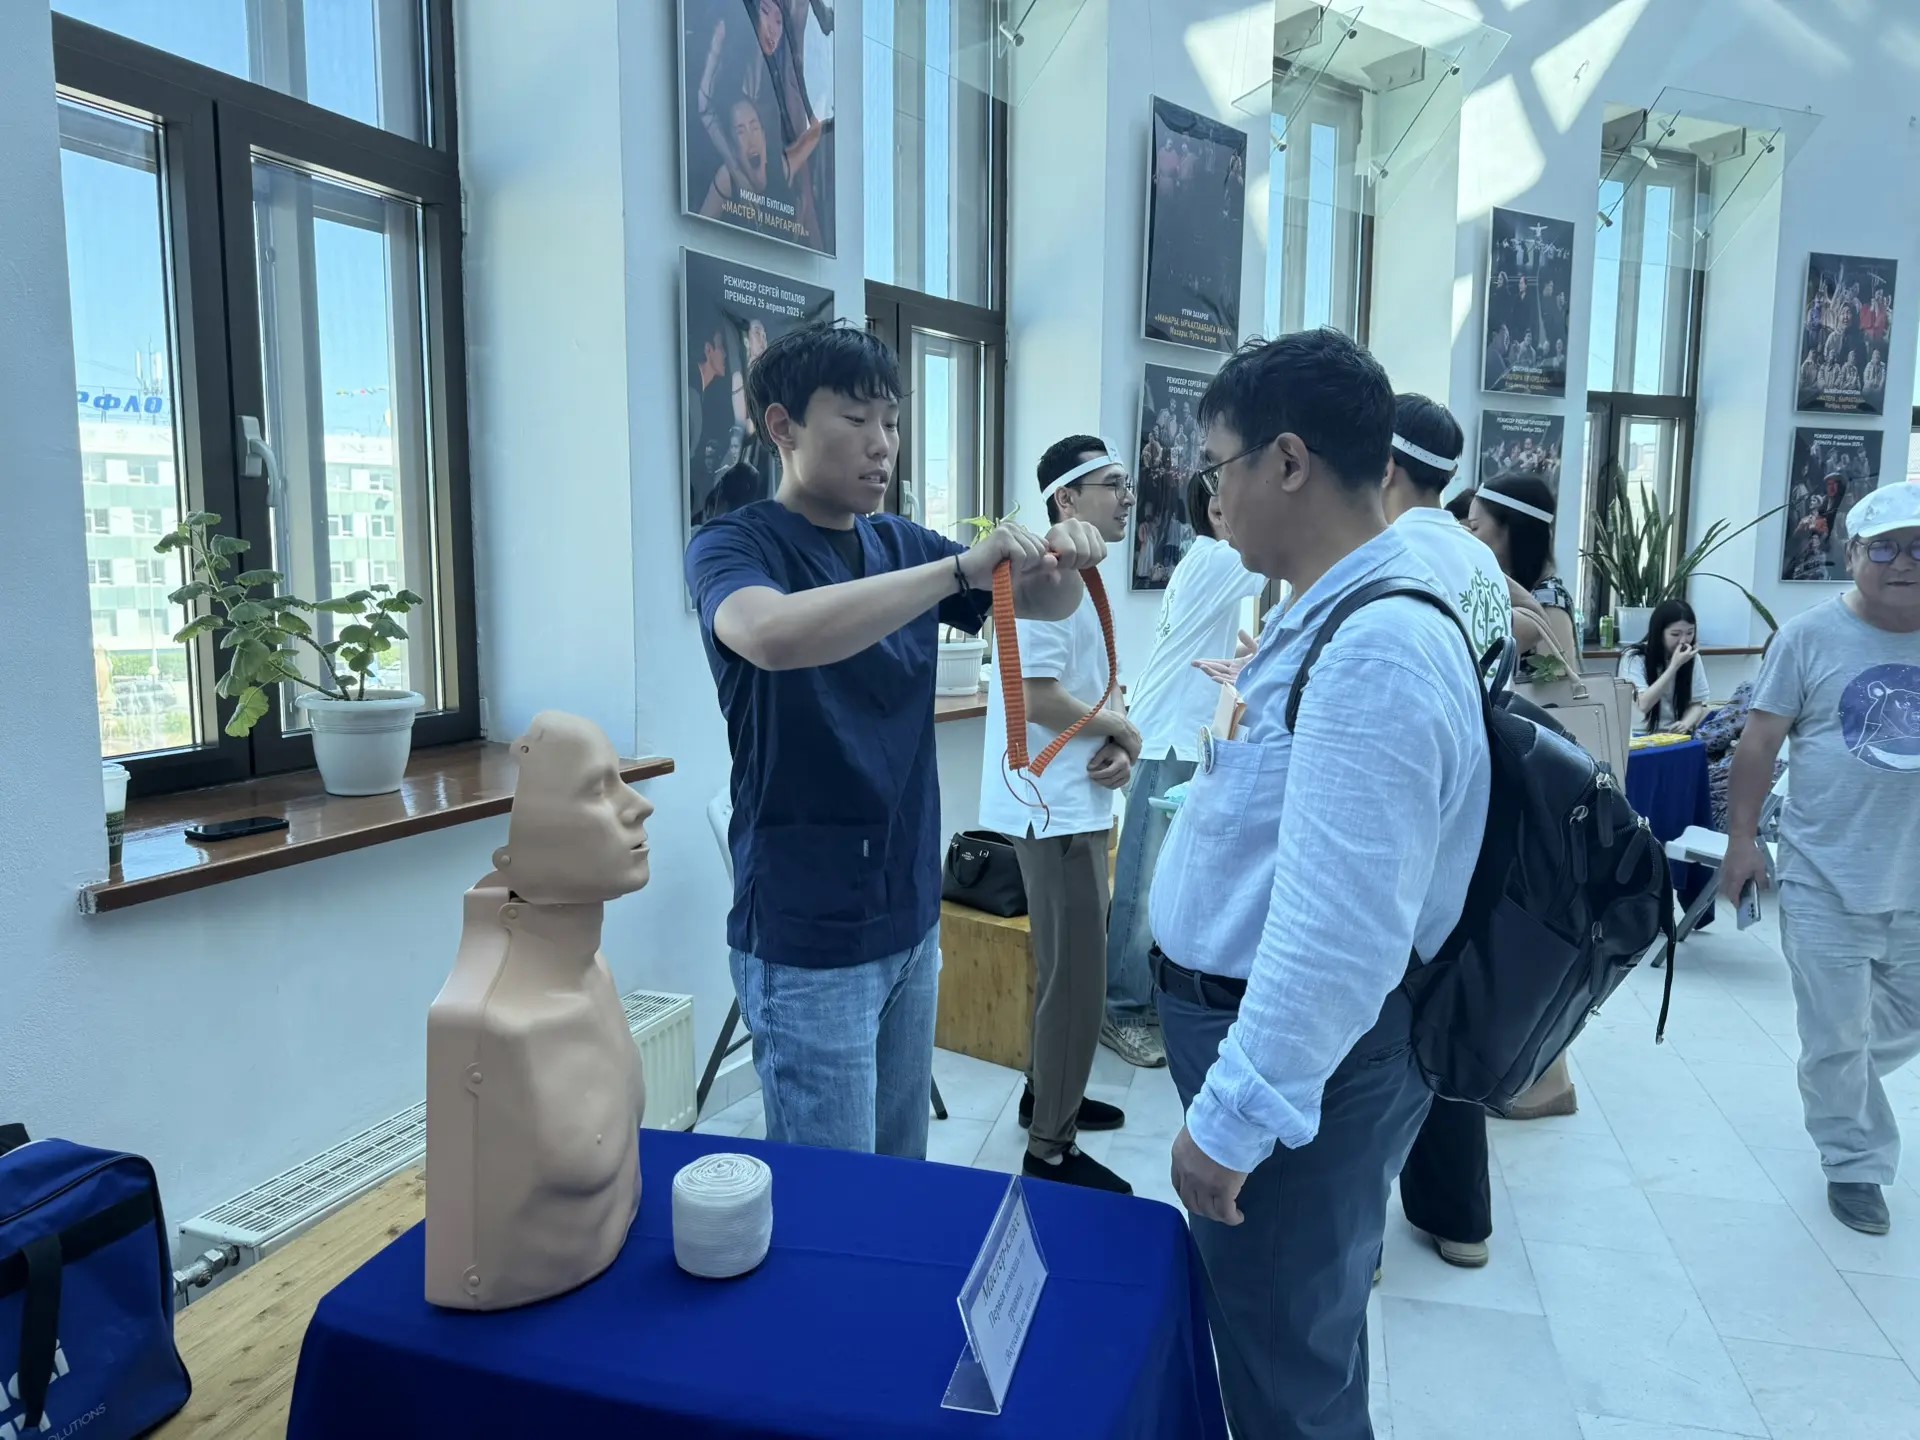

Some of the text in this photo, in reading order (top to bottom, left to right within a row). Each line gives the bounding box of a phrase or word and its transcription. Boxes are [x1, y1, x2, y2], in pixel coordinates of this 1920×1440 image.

[740, 188, 795, 216] МИХАИЛ БУЛГАКОВ
[721, 200, 809, 236] «МАСТЕР И МАРГАРИТА»
[723, 274, 806, 305] РЕЖИССЕР СЕРГЕЙ ПОТАПОВ
[724, 289, 757, 307] ПРЕМЬЕРА
[757, 298, 765, 309] 25
[765, 302, 786, 314] апреля
[786, 306, 800, 317] 2025
[1166, 375, 1187, 386] РЕЖИССЕР
[1187, 379, 1202, 388] СЕРГЕЙ
[1168, 386, 1188, 396] ПРЕМЬЕРА
[982, 1211, 1021, 1307] Мастер-класс
[988, 1289, 1006, 1329] Первая
